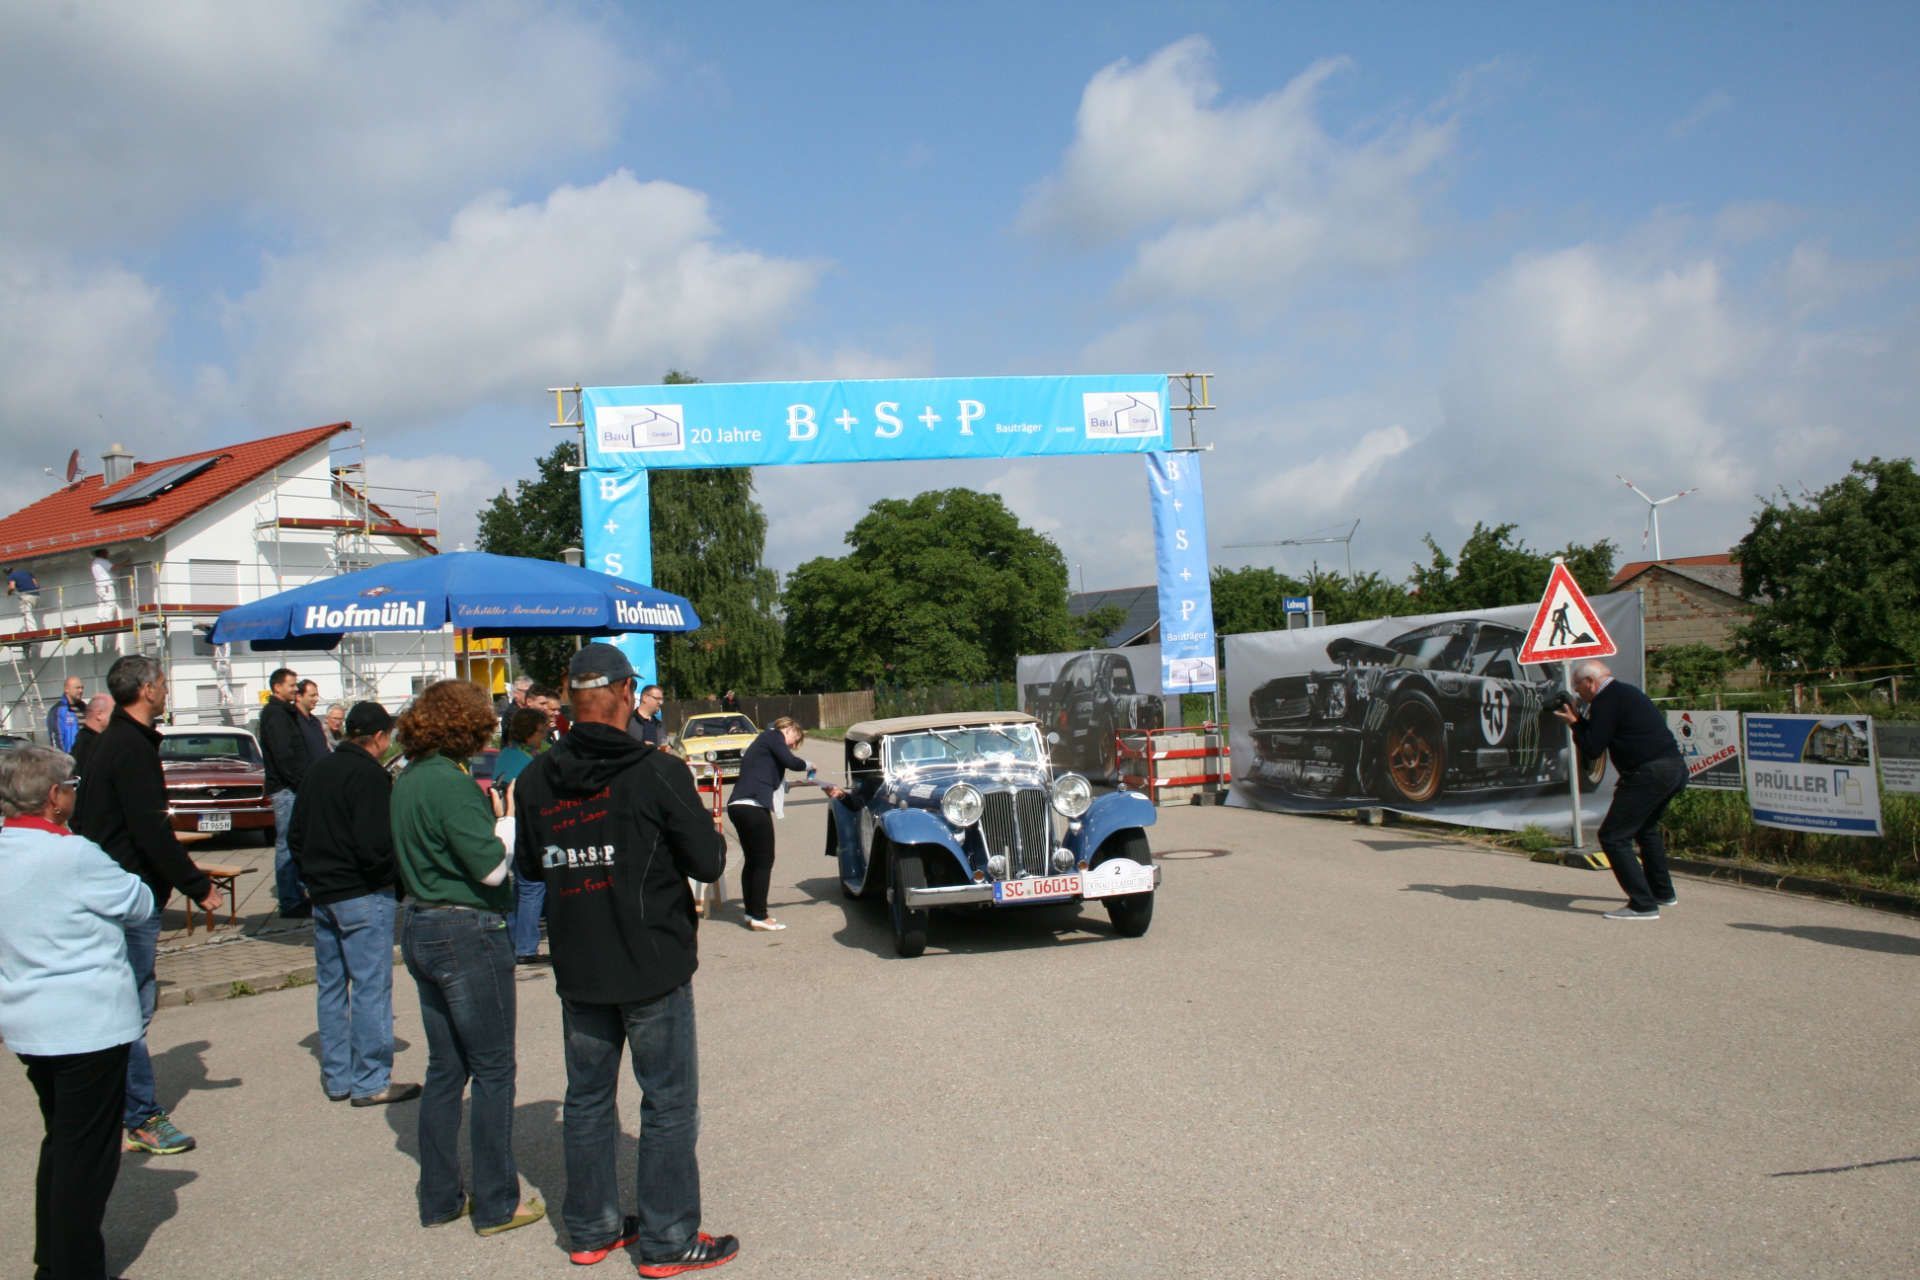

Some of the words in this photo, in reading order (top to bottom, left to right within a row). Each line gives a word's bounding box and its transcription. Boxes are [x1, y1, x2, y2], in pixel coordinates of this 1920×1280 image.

[786, 404, 818, 441] B
[875, 401, 904, 438] S
[957, 400, 985, 436] P
[995, 422, 1042, 435] Bauträger
[1090, 417, 1112, 427] Bau
[604, 431, 629, 441] Bau
[692, 429, 711, 444] 20
[717, 428, 762, 443] Jahre
[305, 601, 425, 628] Hofmühl
[615, 600, 685, 626] Hofmühl
[1689, 745, 1736, 773] HLICKER
[1755, 769, 1828, 793] PRÜLLER
[1114, 866, 1121, 875] 2
[1005, 882, 1024, 897] SC
[1034, 877, 1078, 895] 06015
